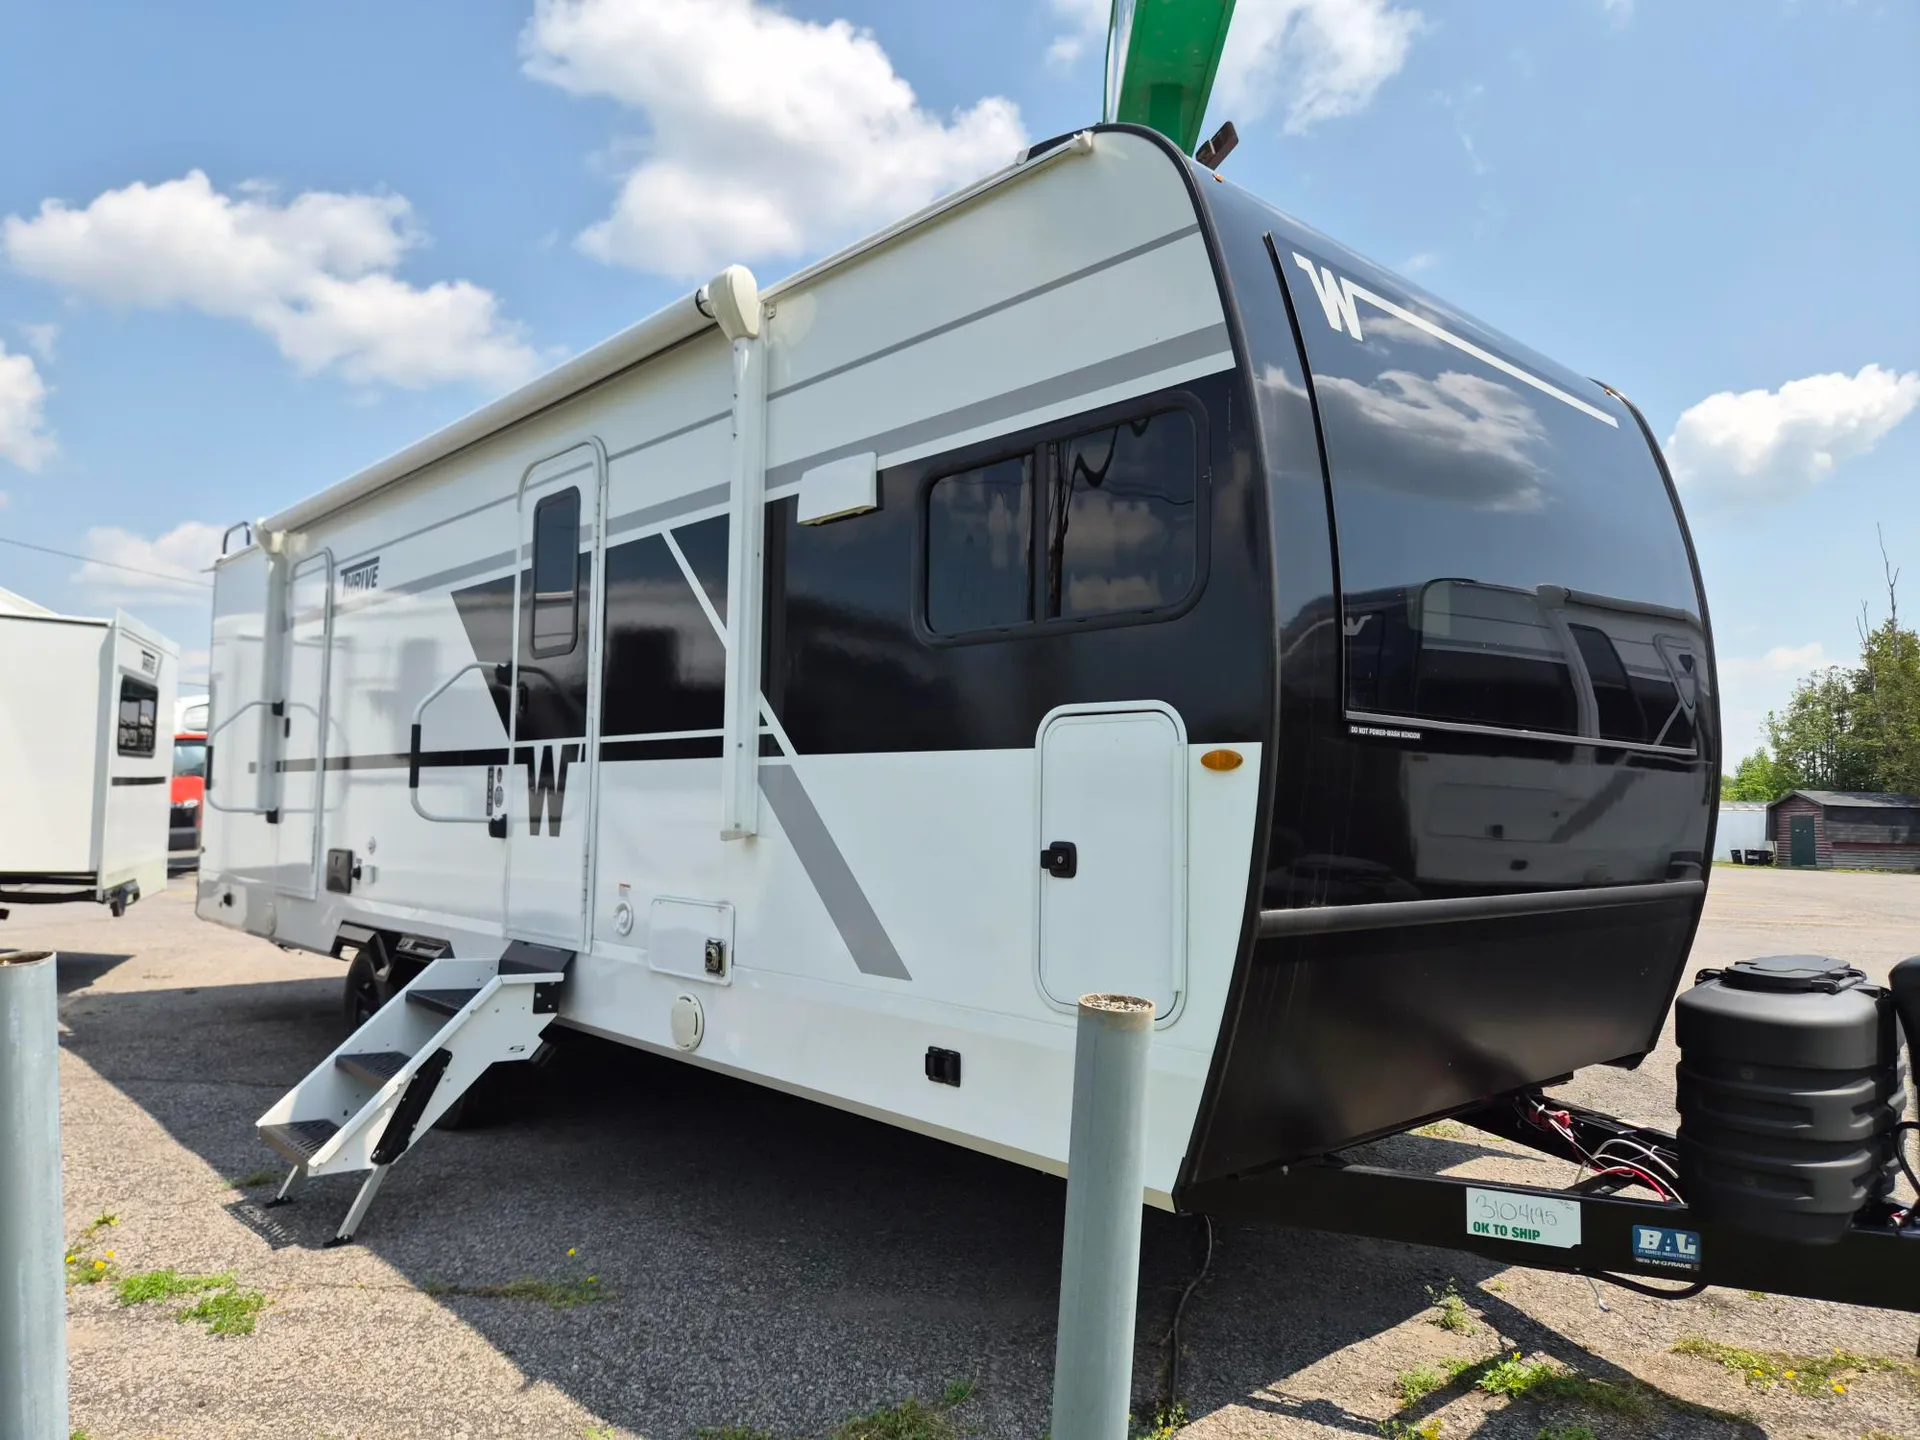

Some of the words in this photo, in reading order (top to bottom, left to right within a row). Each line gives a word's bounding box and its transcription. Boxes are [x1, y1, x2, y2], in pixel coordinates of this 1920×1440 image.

[340, 556, 380, 597] THRIVE
[1475, 1195, 1557, 1226] 3104195
[1473, 1221, 1490, 1234] OK
[1493, 1224, 1508, 1236] TO
[1511, 1226, 1540, 1240] SHIP
